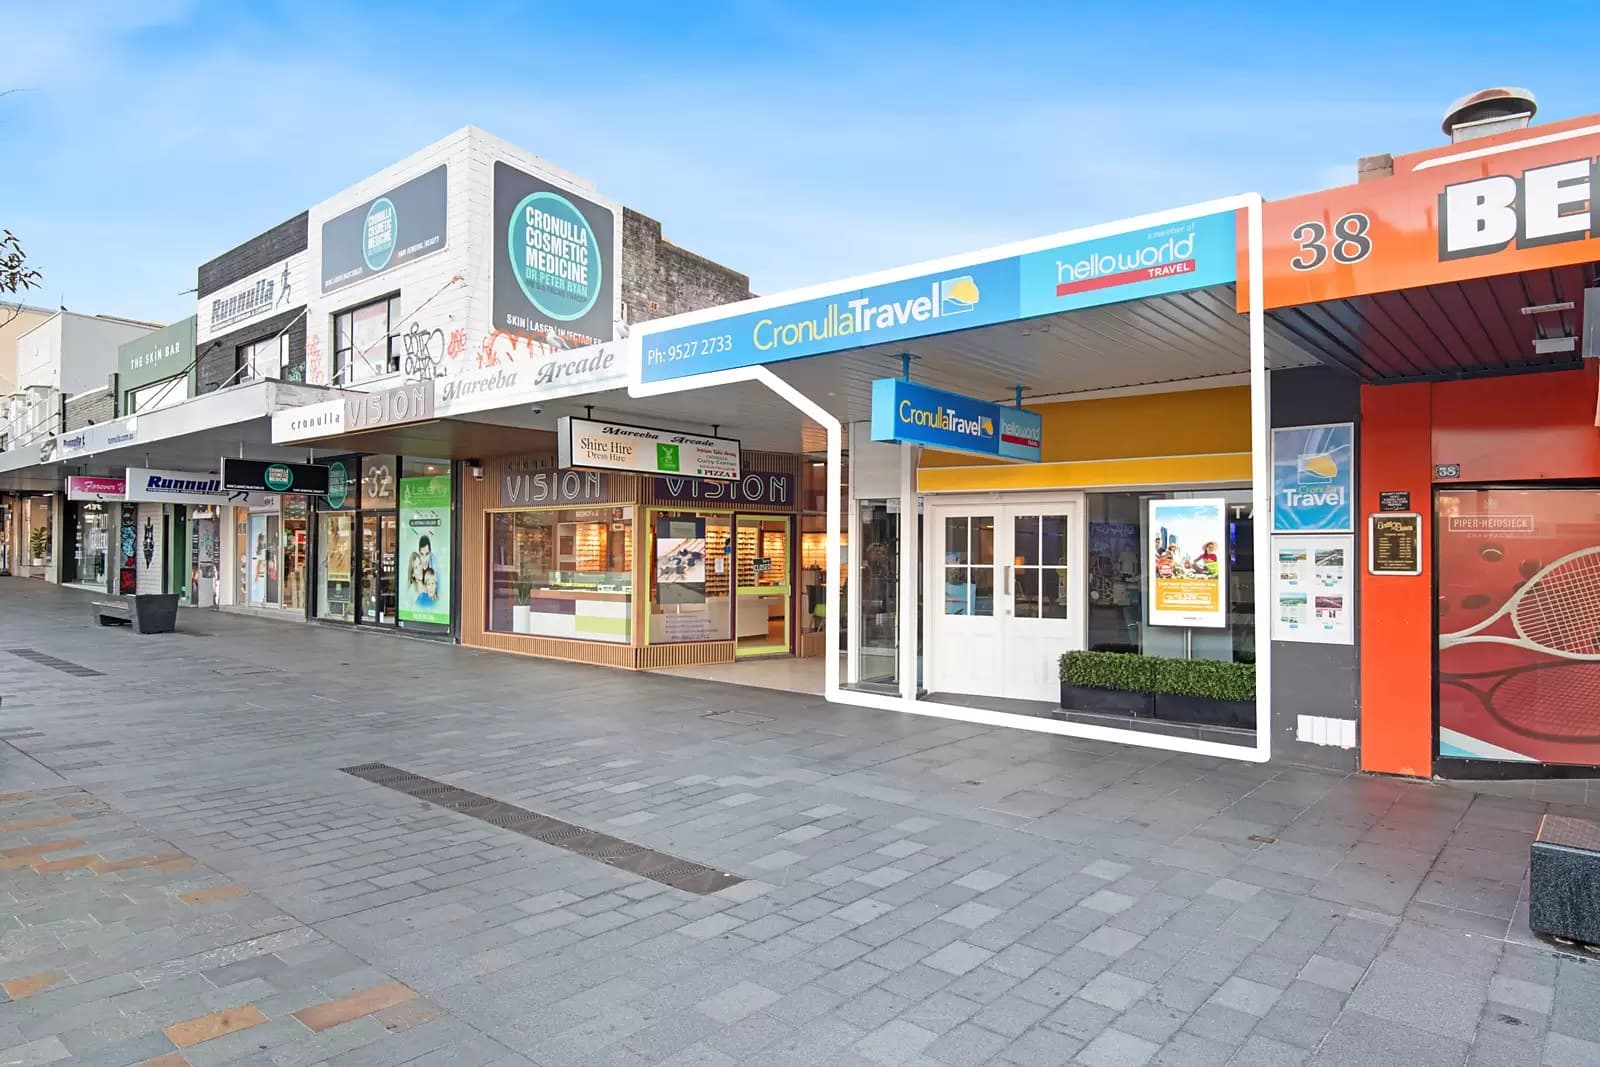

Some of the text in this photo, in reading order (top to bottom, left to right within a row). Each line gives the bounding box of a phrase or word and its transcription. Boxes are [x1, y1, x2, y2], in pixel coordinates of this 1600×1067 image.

[1438, 157, 1600, 262] BE
[525, 206, 588, 246] CRONULLA
[1186, 222, 1196, 231] of
[525, 226, 588, 265] COSMETIC
[1290, 212, 1373, 272] 38
[525, 245, 588, 285] MEDICINE
[1055, 232, 1196, 284] helloworld
[1148, 262, 1191, 278] TRAVEL
[526, 267, 538, 281] DR
[540, 271, 565, 291] PETER
[567, 280, 588, 297] RYAN
[506, 313, 526, 330] SKIN
[131, 355, 143, 369] THE
[165, 341, 180, 357] BAR
[648, 335, 733, 366] Ph: 9527 2733
[442, 368, 518, 402] Mareeba
[534, 348, 615, 387] Arcade
[290, 386, 426, 431] cronulla VISION
[580, 437, 633, 456] Shire Hire
[602, 426, 715, 448] Mareeba Arcade
[587, 450, 626, 463] Dress Hire
[696, 457, 714, 465] Curry
[147, 475, 222, 492] Runnull
[506, 471, 601, 503] VISION
[665, 473, 787, 503] VISION
[704, 469, 731, 478] PIZZA
[1282, 486, 1345, 507] Travel
